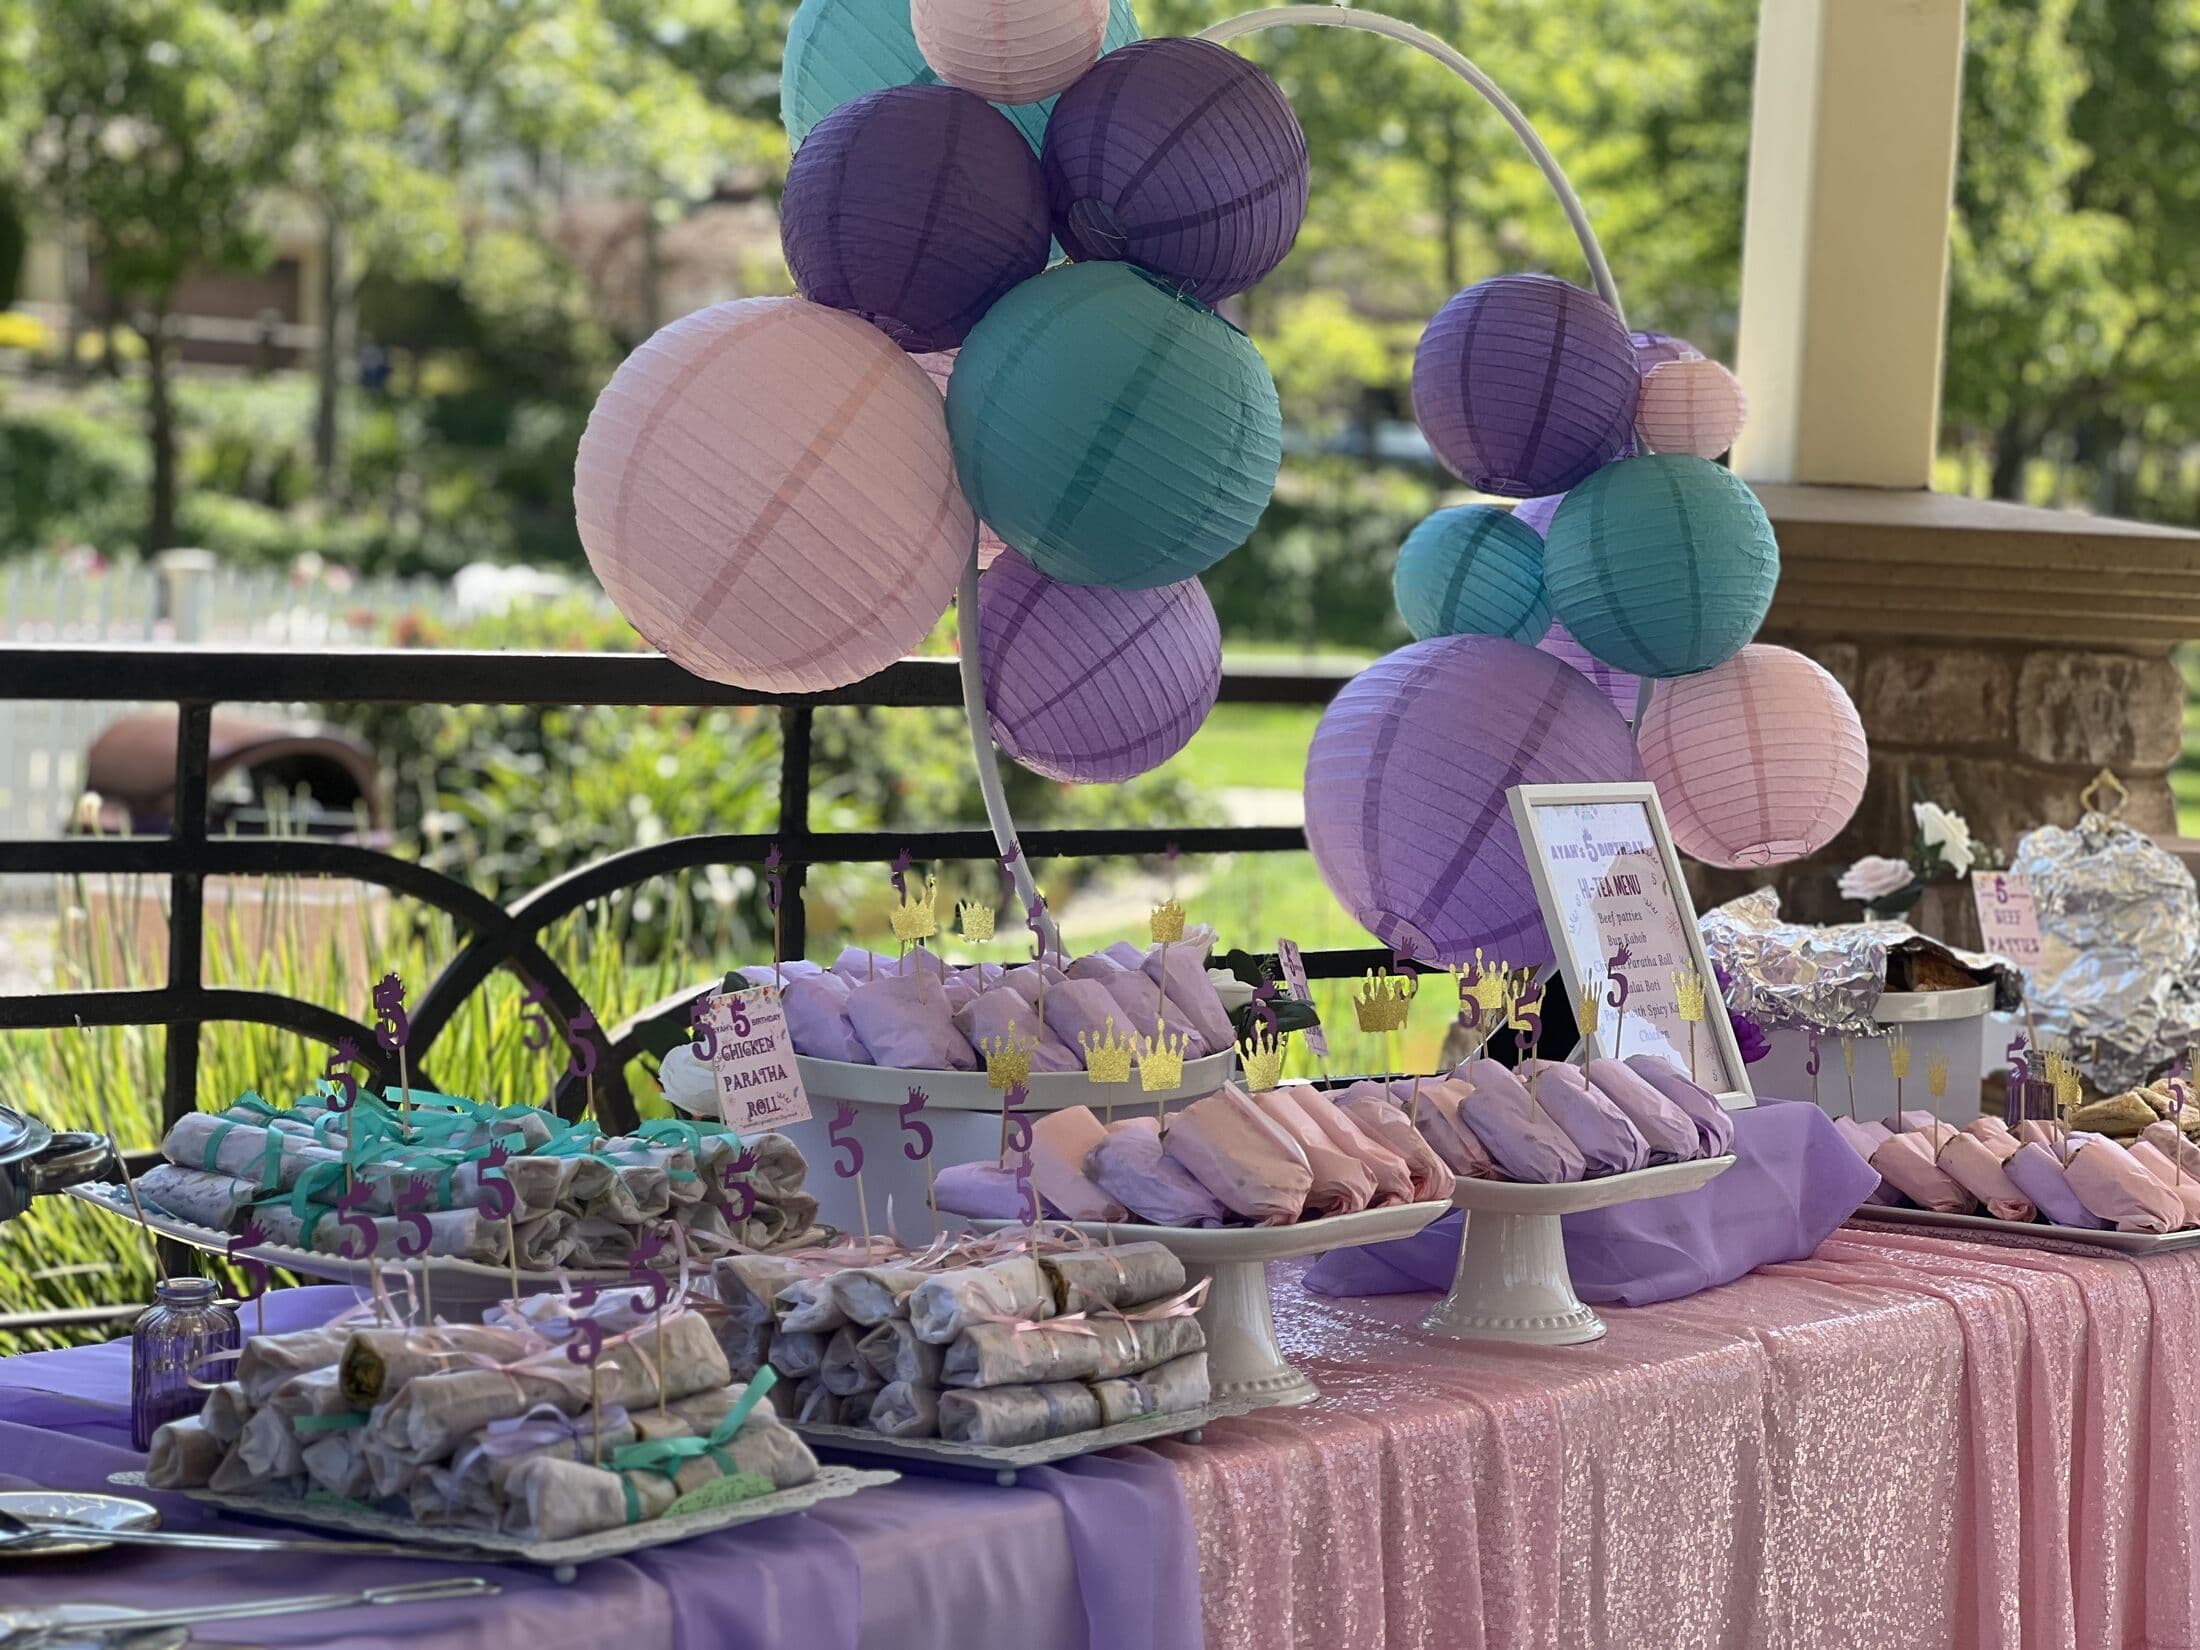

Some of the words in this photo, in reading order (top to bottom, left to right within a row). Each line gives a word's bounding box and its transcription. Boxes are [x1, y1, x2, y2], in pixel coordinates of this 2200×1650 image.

[1582, 828, 1598, 862] 5
[1612, 874, 1641, 897] MENU
[1994, 875, 2008, 904] 5
[1597, 911, 1615, 927] Beef
[1616, 910, 1643, 925] patties
[1607, 934, 1623, 946] Bun
[1624, 932, 1647, 944] Kabob
[1607, 942, 1632, 1007] 5
[1627, 955, 1657, 969] Paratha
[1657, 953, 1674, 966] Roll
[1645, 980, 1661, 992] Boti
[521, 979, 550, 1050] 5
[691, 993, 717, 1061] 5
[729, 996, 751, 1038] 5
[751, 1014, 781, 1026] BIRTHDAY
[1459, 966, 1482, 1028] 5
[1514, 981, 1542, 1049] 5
[1647, 1004, 1668, 1019] Spicy
[567, 1003, 597, 1077] 5
[721, 1035, 776, 1061] CHICKEN
[2006, 1032, 2028, 1087] 5
[327, 1036, 359, 1112] 5
[723, 1064, 788, 1092] PARATHA
[2168, 1058, 2183, 1115] 5
[746, 1096, 781, 1118] ROLL
[829, 1101, 864, 1178] 5
[900, 1086, 933, 1160] 5
[1004, 1081, 1033, 1152] 5
[477, 1139, 517, 1220] 5
[720, 1146, 759, 1222] 5
[338, 1174, 379, 1260] 5
[396, 1175, 434, 1255] 5
[225, 1219, 271, 1301] 5
[630, 1227, 668, 1314] 5
[566, 1278, 602, 1364] 5
